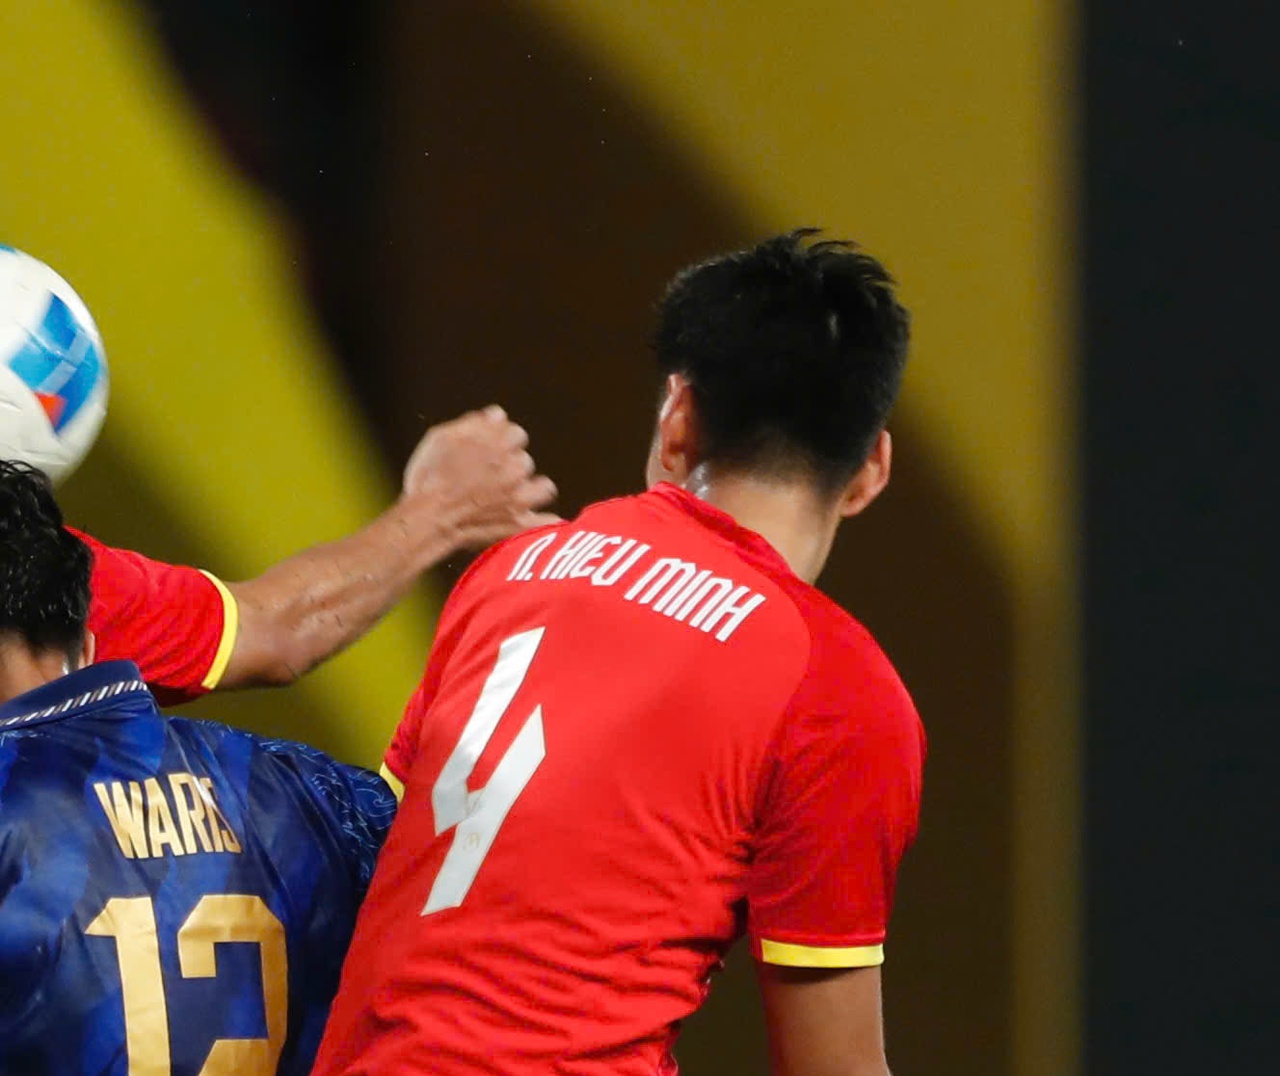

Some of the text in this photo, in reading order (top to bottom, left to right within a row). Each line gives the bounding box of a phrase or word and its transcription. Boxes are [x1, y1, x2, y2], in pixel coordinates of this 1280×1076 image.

[539, 530, 652, 586] HIEU
[623, 557, 767, 642] MINH
[420, 626, 546, 917] 4
